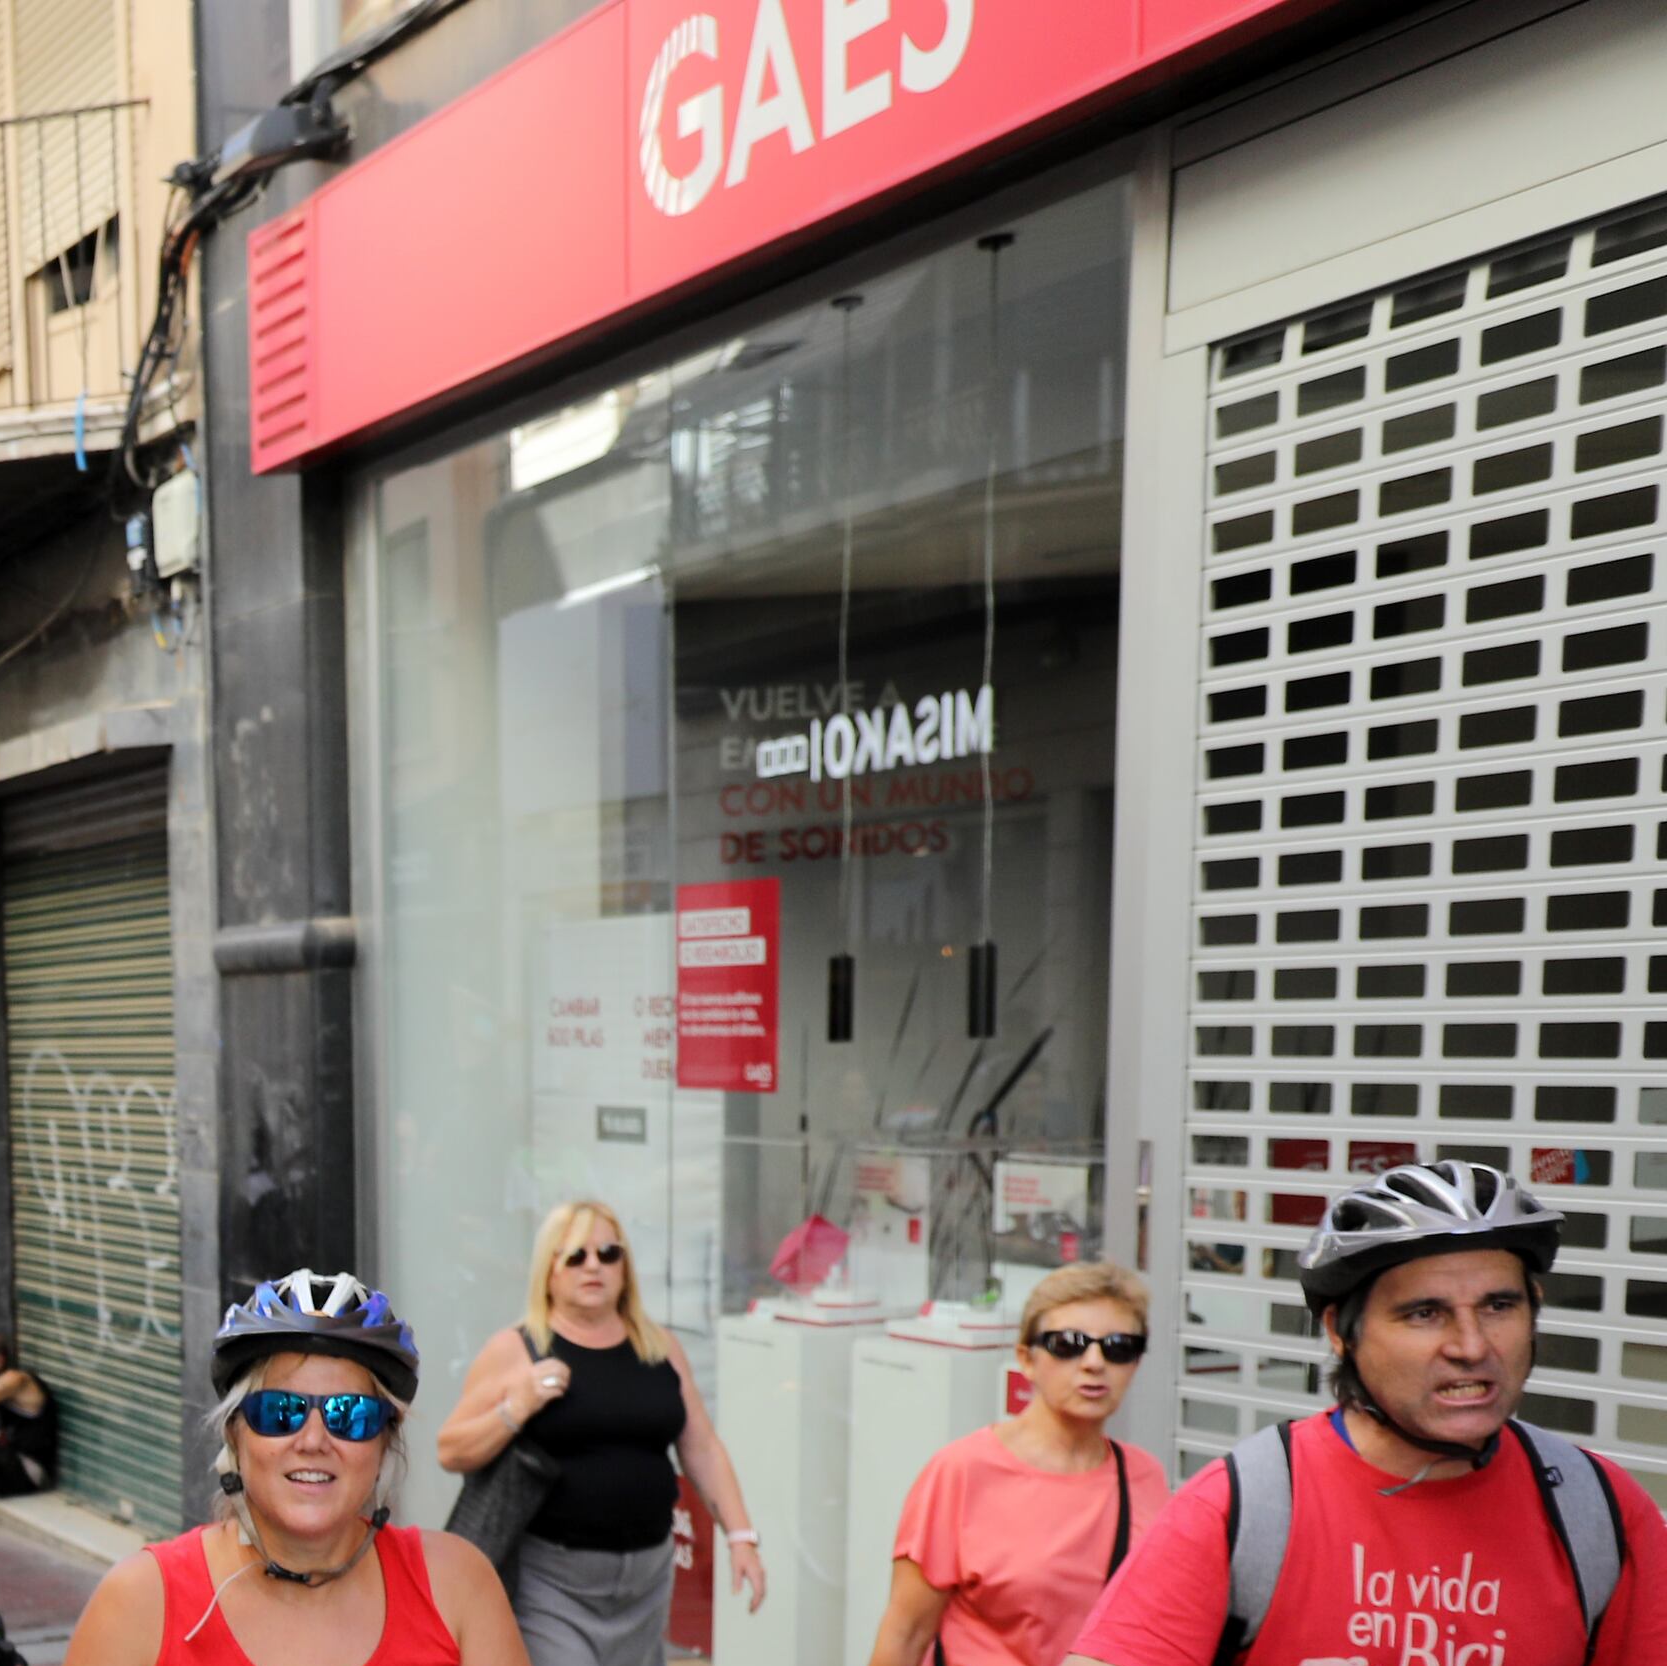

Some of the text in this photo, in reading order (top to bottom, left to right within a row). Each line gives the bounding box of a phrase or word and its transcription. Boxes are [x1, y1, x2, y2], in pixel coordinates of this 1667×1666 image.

[720, 682, 863, 722] VUELVE
[719, 783, 807, 816] CON
[887, 766, 1035, 804] MUNDO
[722, 820, 949, 864] DE SONIDOS
[1352, 1542, 1501, 1616] la vida
[1348, 1610, 1396, 1648] en
